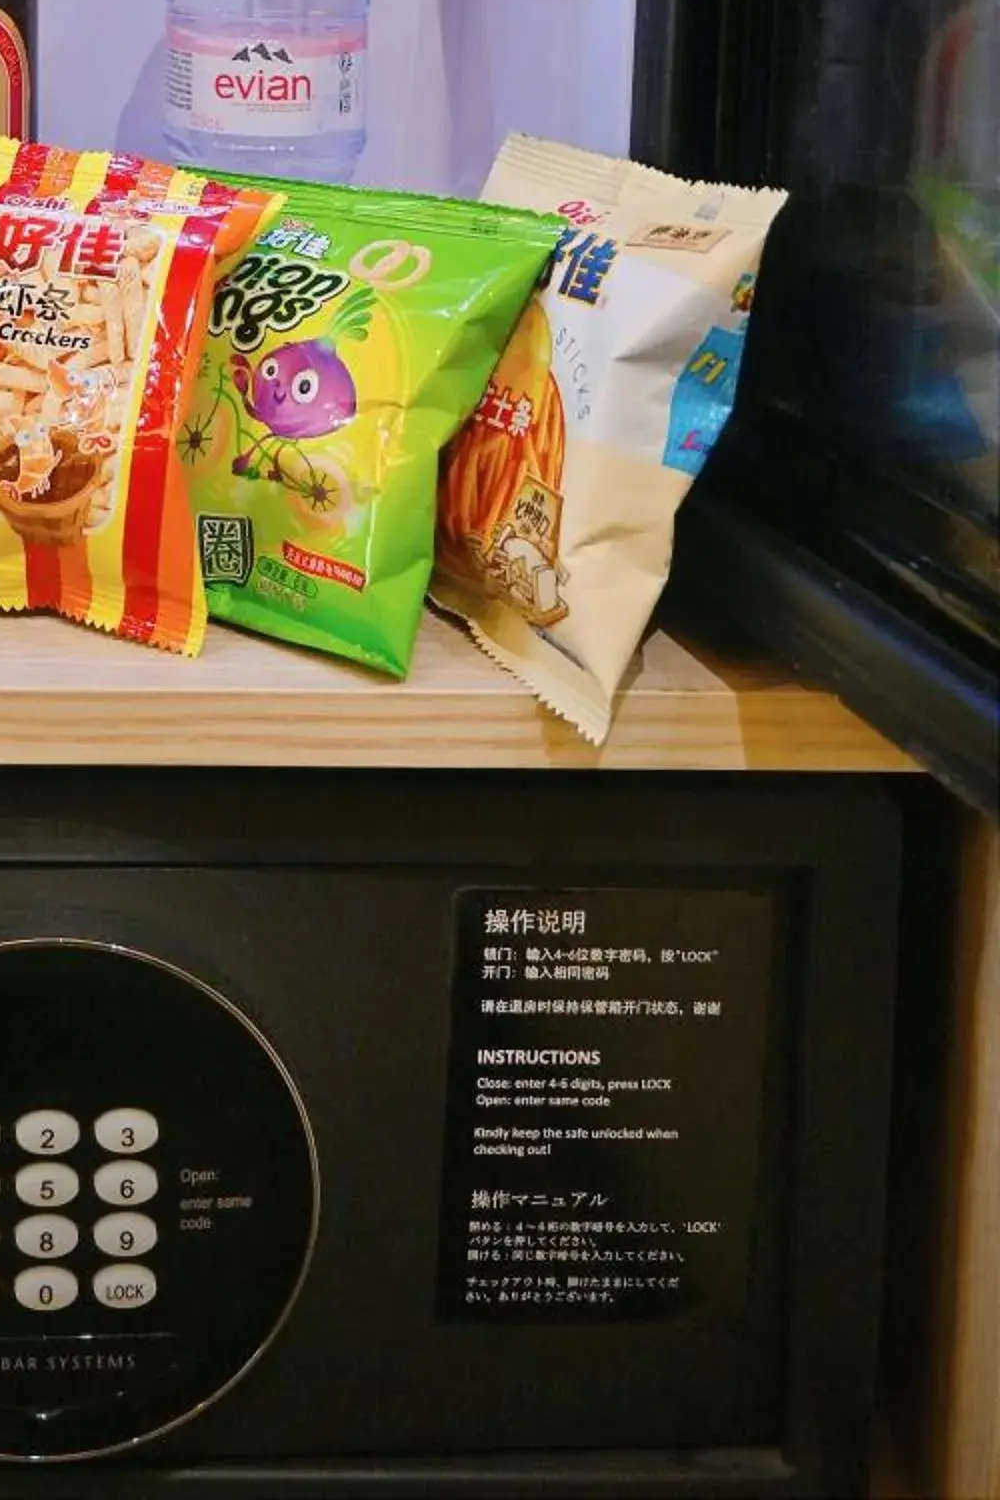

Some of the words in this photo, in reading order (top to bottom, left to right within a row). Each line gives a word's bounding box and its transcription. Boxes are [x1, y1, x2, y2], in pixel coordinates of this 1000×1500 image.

[214, 70, 312, 100] evian
[555, 327, 591, 420] STICKS
[484, 909, 586, 934] 操作说明
[477, 1050, 601, 1065] INSTRUCTIONS
[476, 1078, 512, 1090] Close:
[515, 1078, 546, 1090] enter
[548, 1078, 568, 1090] 4-6
[608, 1080, 639, 1092] press
[641, 1079, 672, 1091] LOCK
[476, 1095, 511, 1108] Open:
[514, 1095, 547, 1107] enter
[549, 1097, 579, 1107] same
[581, 1095, 611, 1107] code
[40, 1129, 55, 1149] 2
[121, 1128, 135, 1148] 3
[474, 1128, 509, 1142] Kindly
[511, 1128, 541, 1142] keep
[543, 1128, 562, 1140] the
[565, 1128, 589, 1140] safe
[592, 1128, 643, 1141] unlocked
[645, 1128, 679, 1140] when
[473, 1144, 525, 1157] checking
[40, 1181, 55, 1201] 5
[120, 1179, 134, 1199] 6
[471, 1189, 609, 1208] 操作マニュアル
[179, 1196, 214, 1211] enter
[216, 1196, 254, 1209] same
[179, 1216, 213, 1230] code
[40, 1232, 54, 1253] 8
[119, 1231, 134, 1251] 9
[39, 1285, 53, 1306] 0
[105, 1283, 145, 1301] LOCK
[46, 1353, 137, 1371] SYSTEMS
